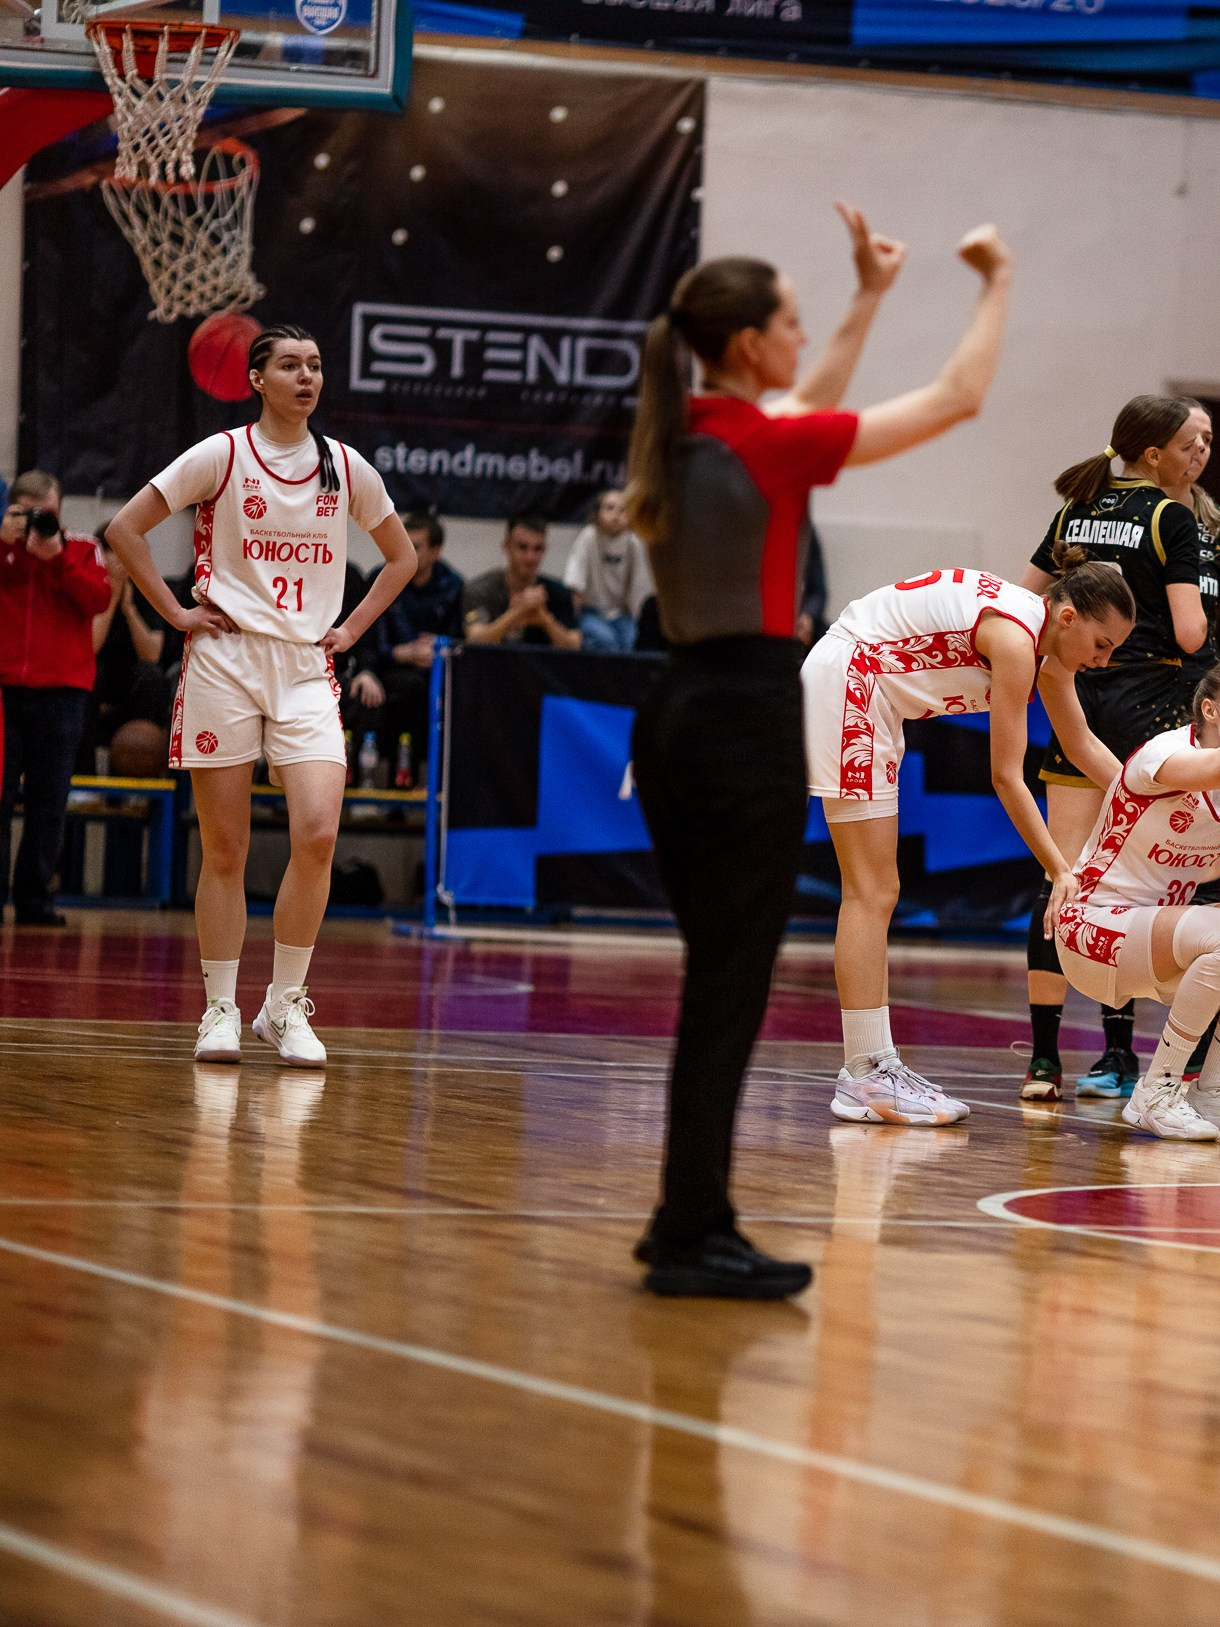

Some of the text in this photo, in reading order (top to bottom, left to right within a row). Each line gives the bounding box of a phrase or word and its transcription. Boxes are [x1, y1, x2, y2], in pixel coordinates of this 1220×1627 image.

[369, 323, 641, 388] STEND
[374, 442, 627, 483] stendmebel.ru
[316, 495, 339, 505] FON
[316, 507, 339, 516] BET
[250, 528, 311, 538] БАСКЕТБОЛЬНЫЙ
[1065, 519, 1144, 549] СЕДЛЕЦКАЯ
[243, 538, 333, 564] ЮНОСТЬ
[272, 576, 303, 612] 21
